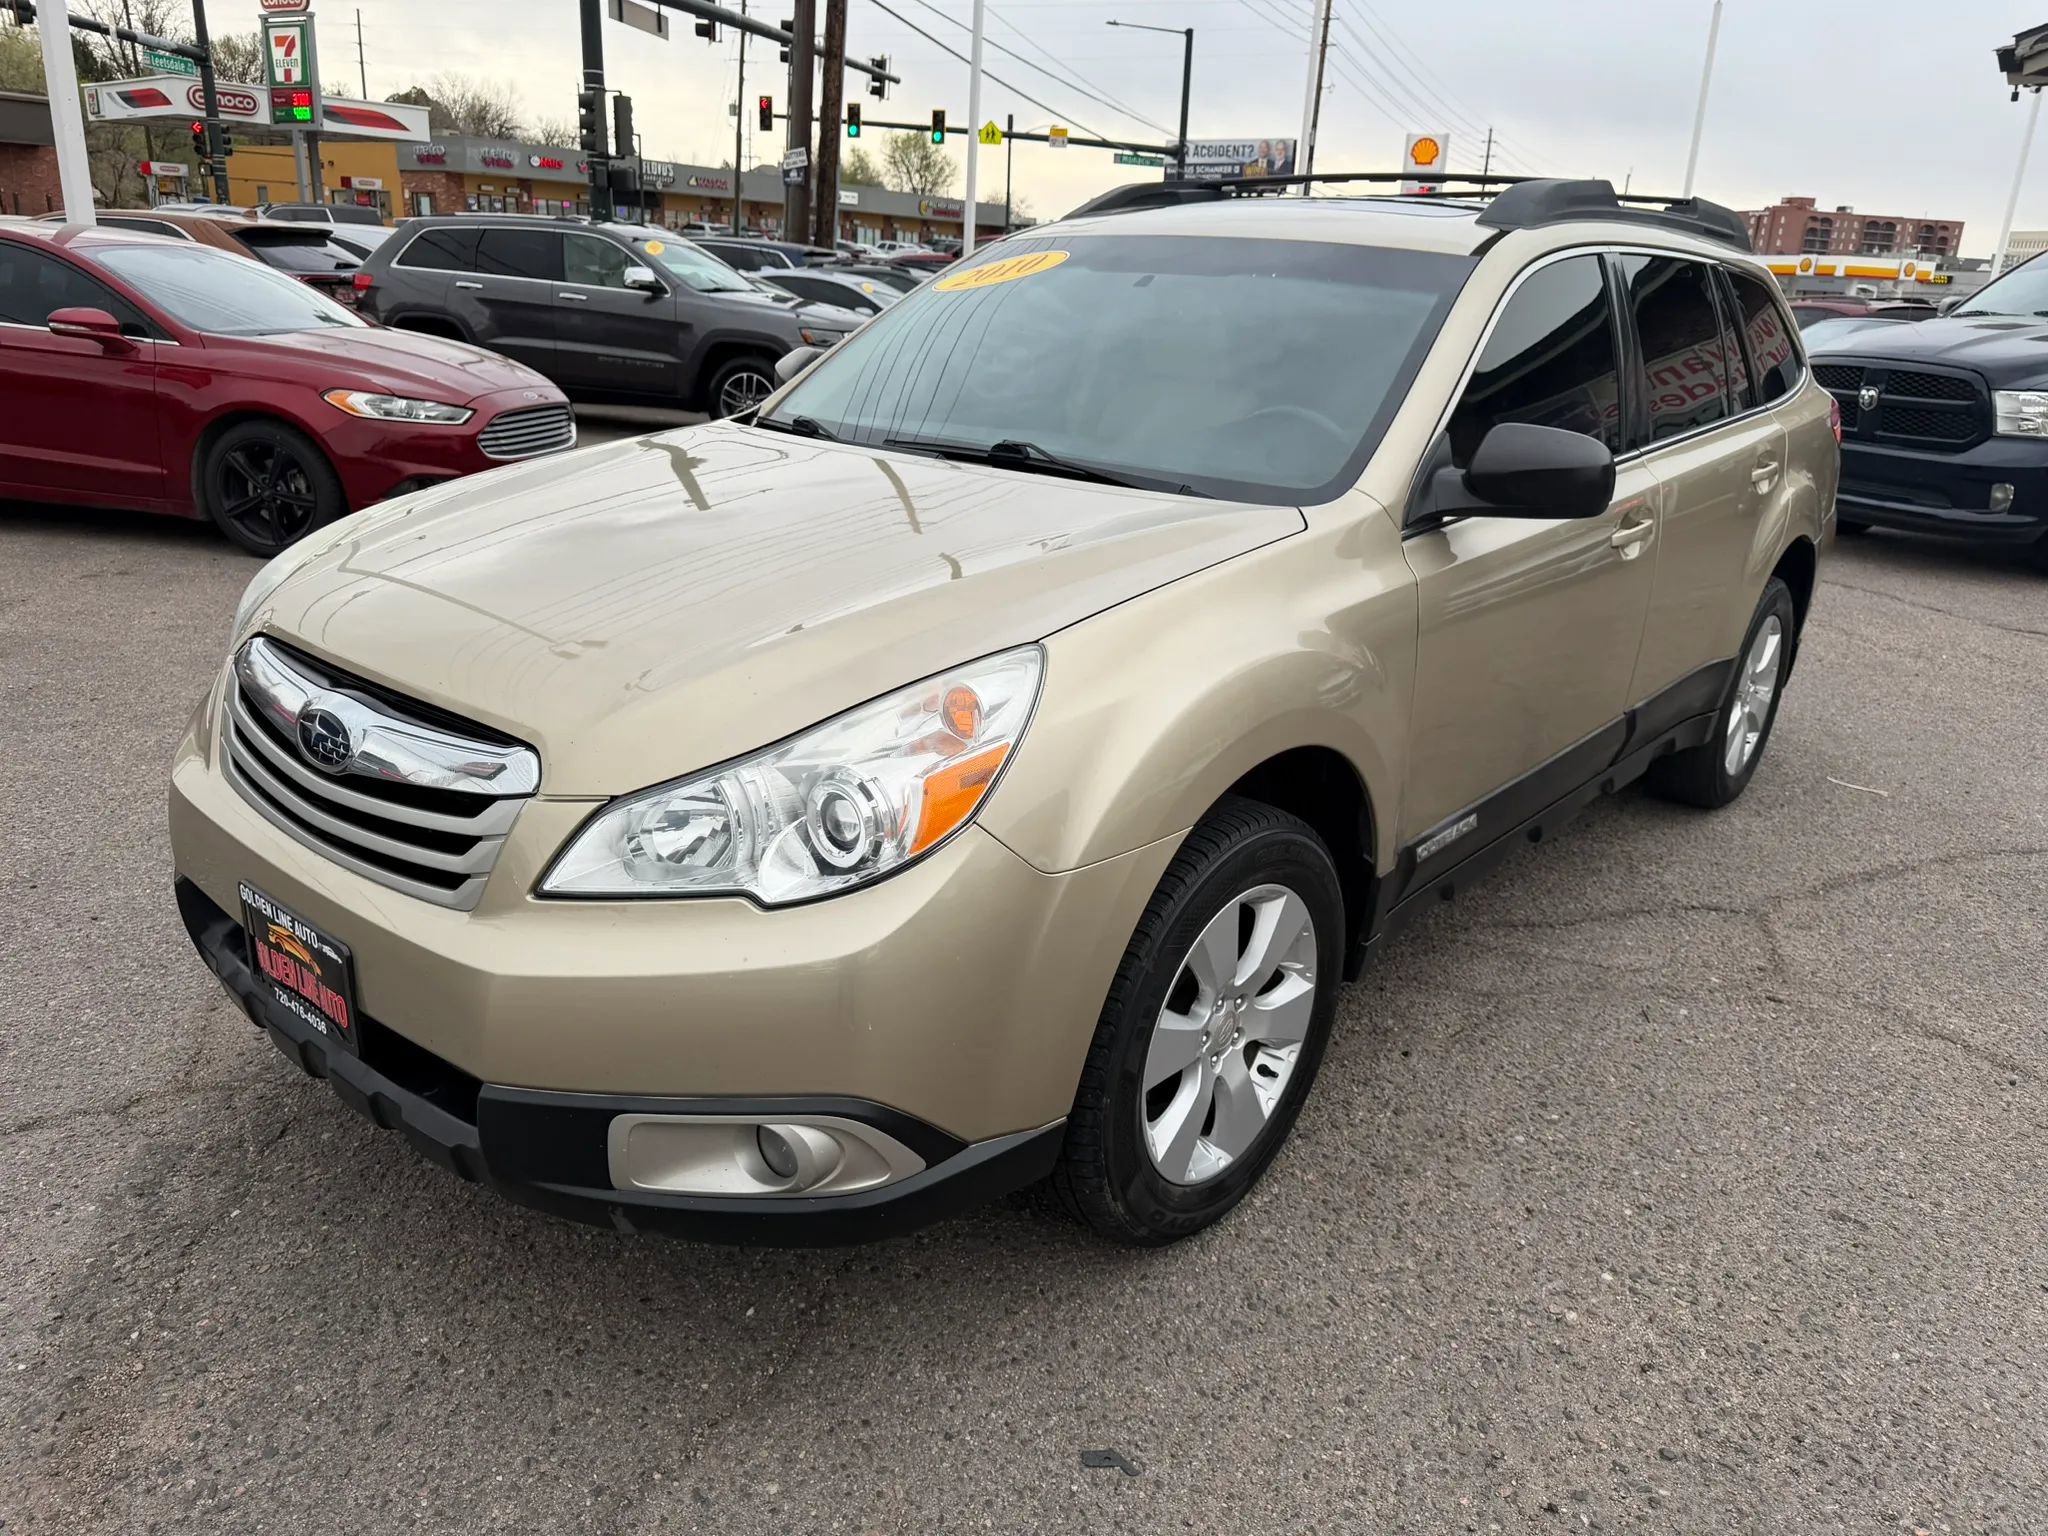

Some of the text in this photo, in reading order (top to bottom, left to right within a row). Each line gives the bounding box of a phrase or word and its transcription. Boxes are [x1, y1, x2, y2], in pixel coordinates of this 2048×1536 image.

[151, 55, 185, 71] Leetsdale
[194, 92, 255, 110] cnoco
[1193, 144, 1255, 158] ACCIDENT?
[239, 884, 319, 949] GOLDEN LINE AUTO
